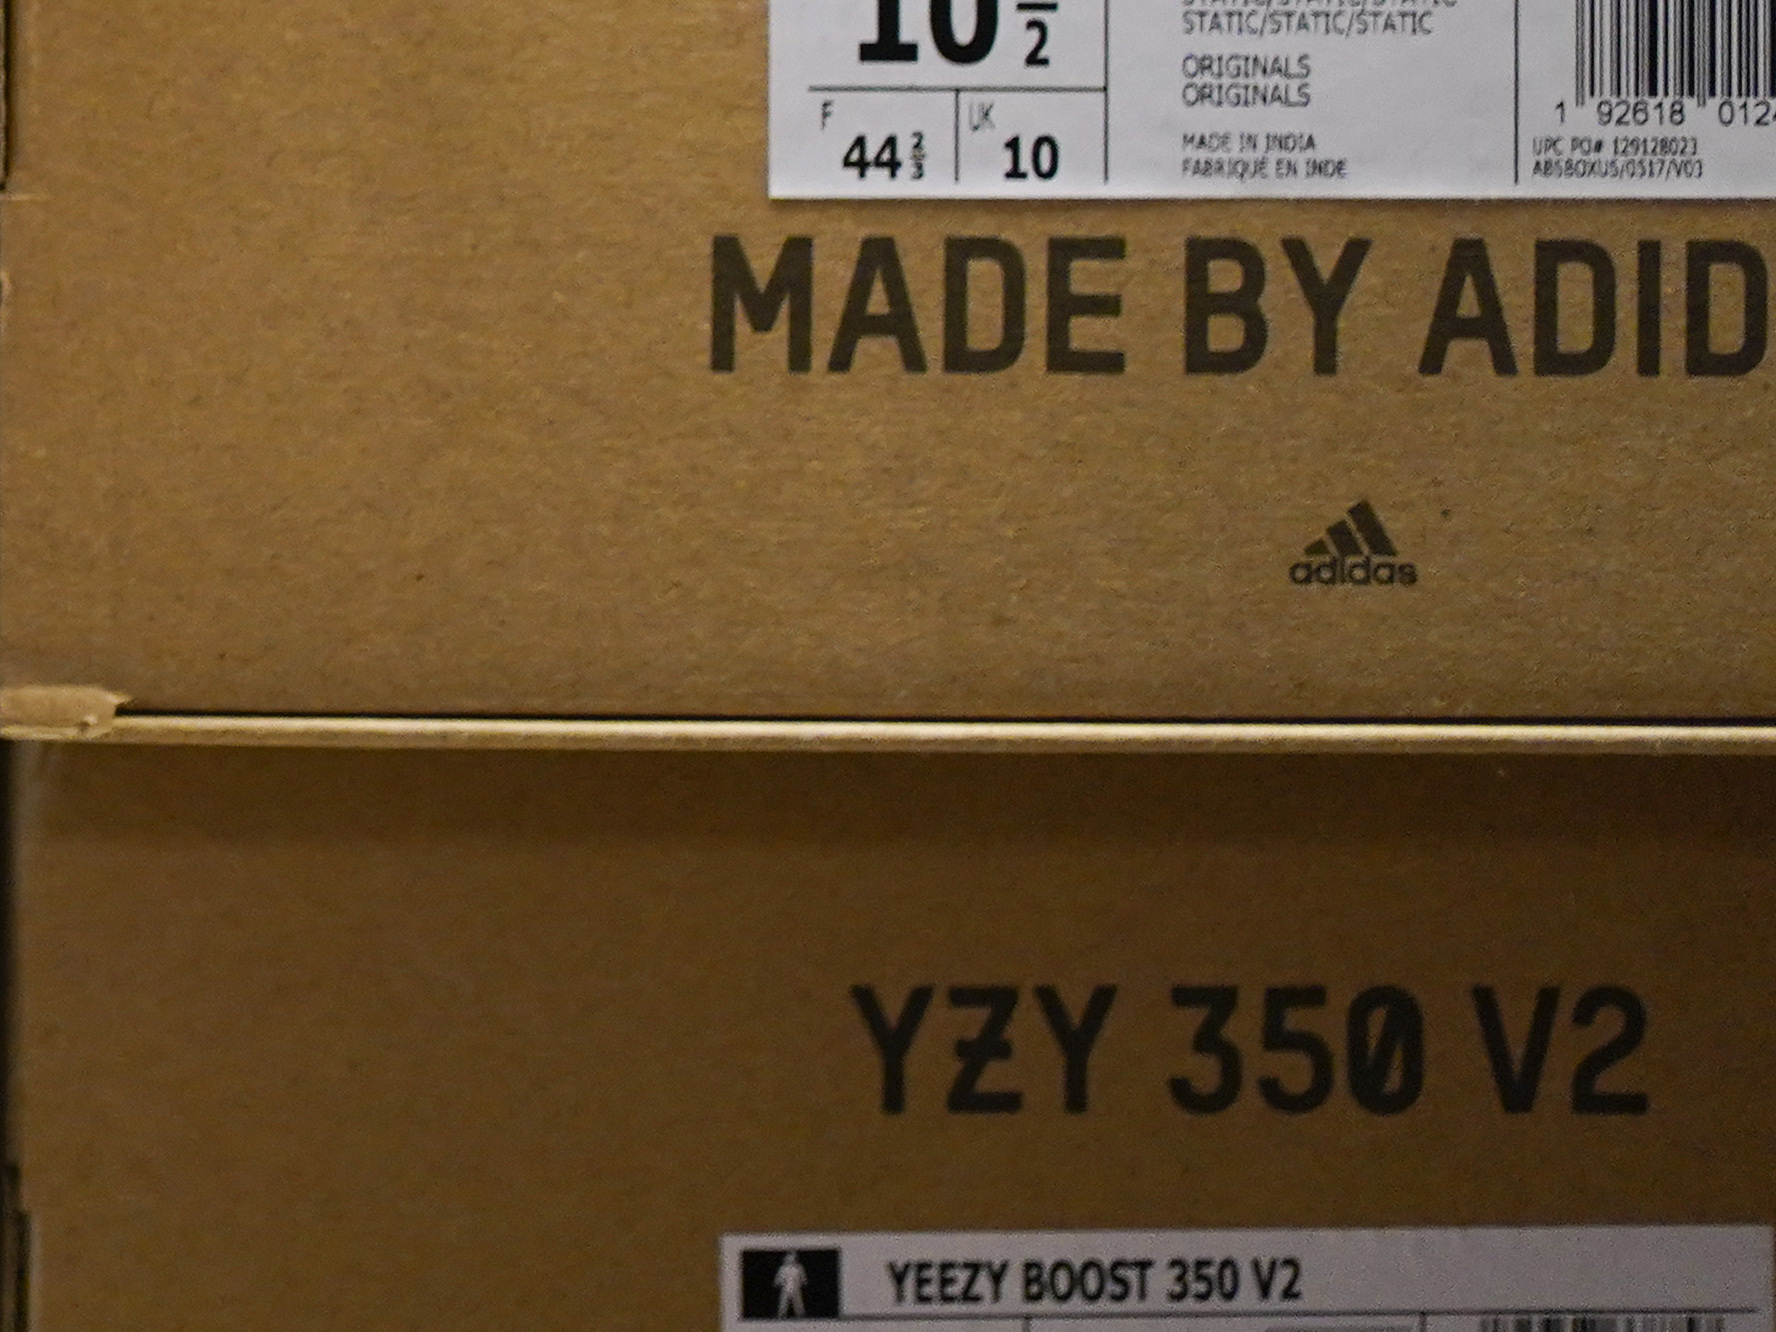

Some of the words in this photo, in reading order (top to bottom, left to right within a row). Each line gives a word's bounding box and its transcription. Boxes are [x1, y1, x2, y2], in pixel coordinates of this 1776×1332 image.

[1183, 7, 1432, 36] STATIC/STATIC/STATIC
[1183, 54, 1311, 79] ORIGINALS
[1183, 83, 1310, 107] ORIGINALS
[971, 104, 993, 132] UK
[1005, 135, 1058, 179] 10
[711, 235, 1127, 376] MADE
[1184, 237, 1371, 376] BY
[1419, 238, 1768, 378] ADID
[1289, 555, 1418, 586] adidas
[851, 985, 1117, 1115] YZY
[1169, 984, 1425, 1116] 350
[1471, 984, 1649, 1116] V2
[889, 1261, 1008, 1305] YEEZY
[1023, 1259, 1154, 1303] BOOST
[1168, 1258, 1240, 1302] 350
[1252, 1258, 1301, 1300] V2
